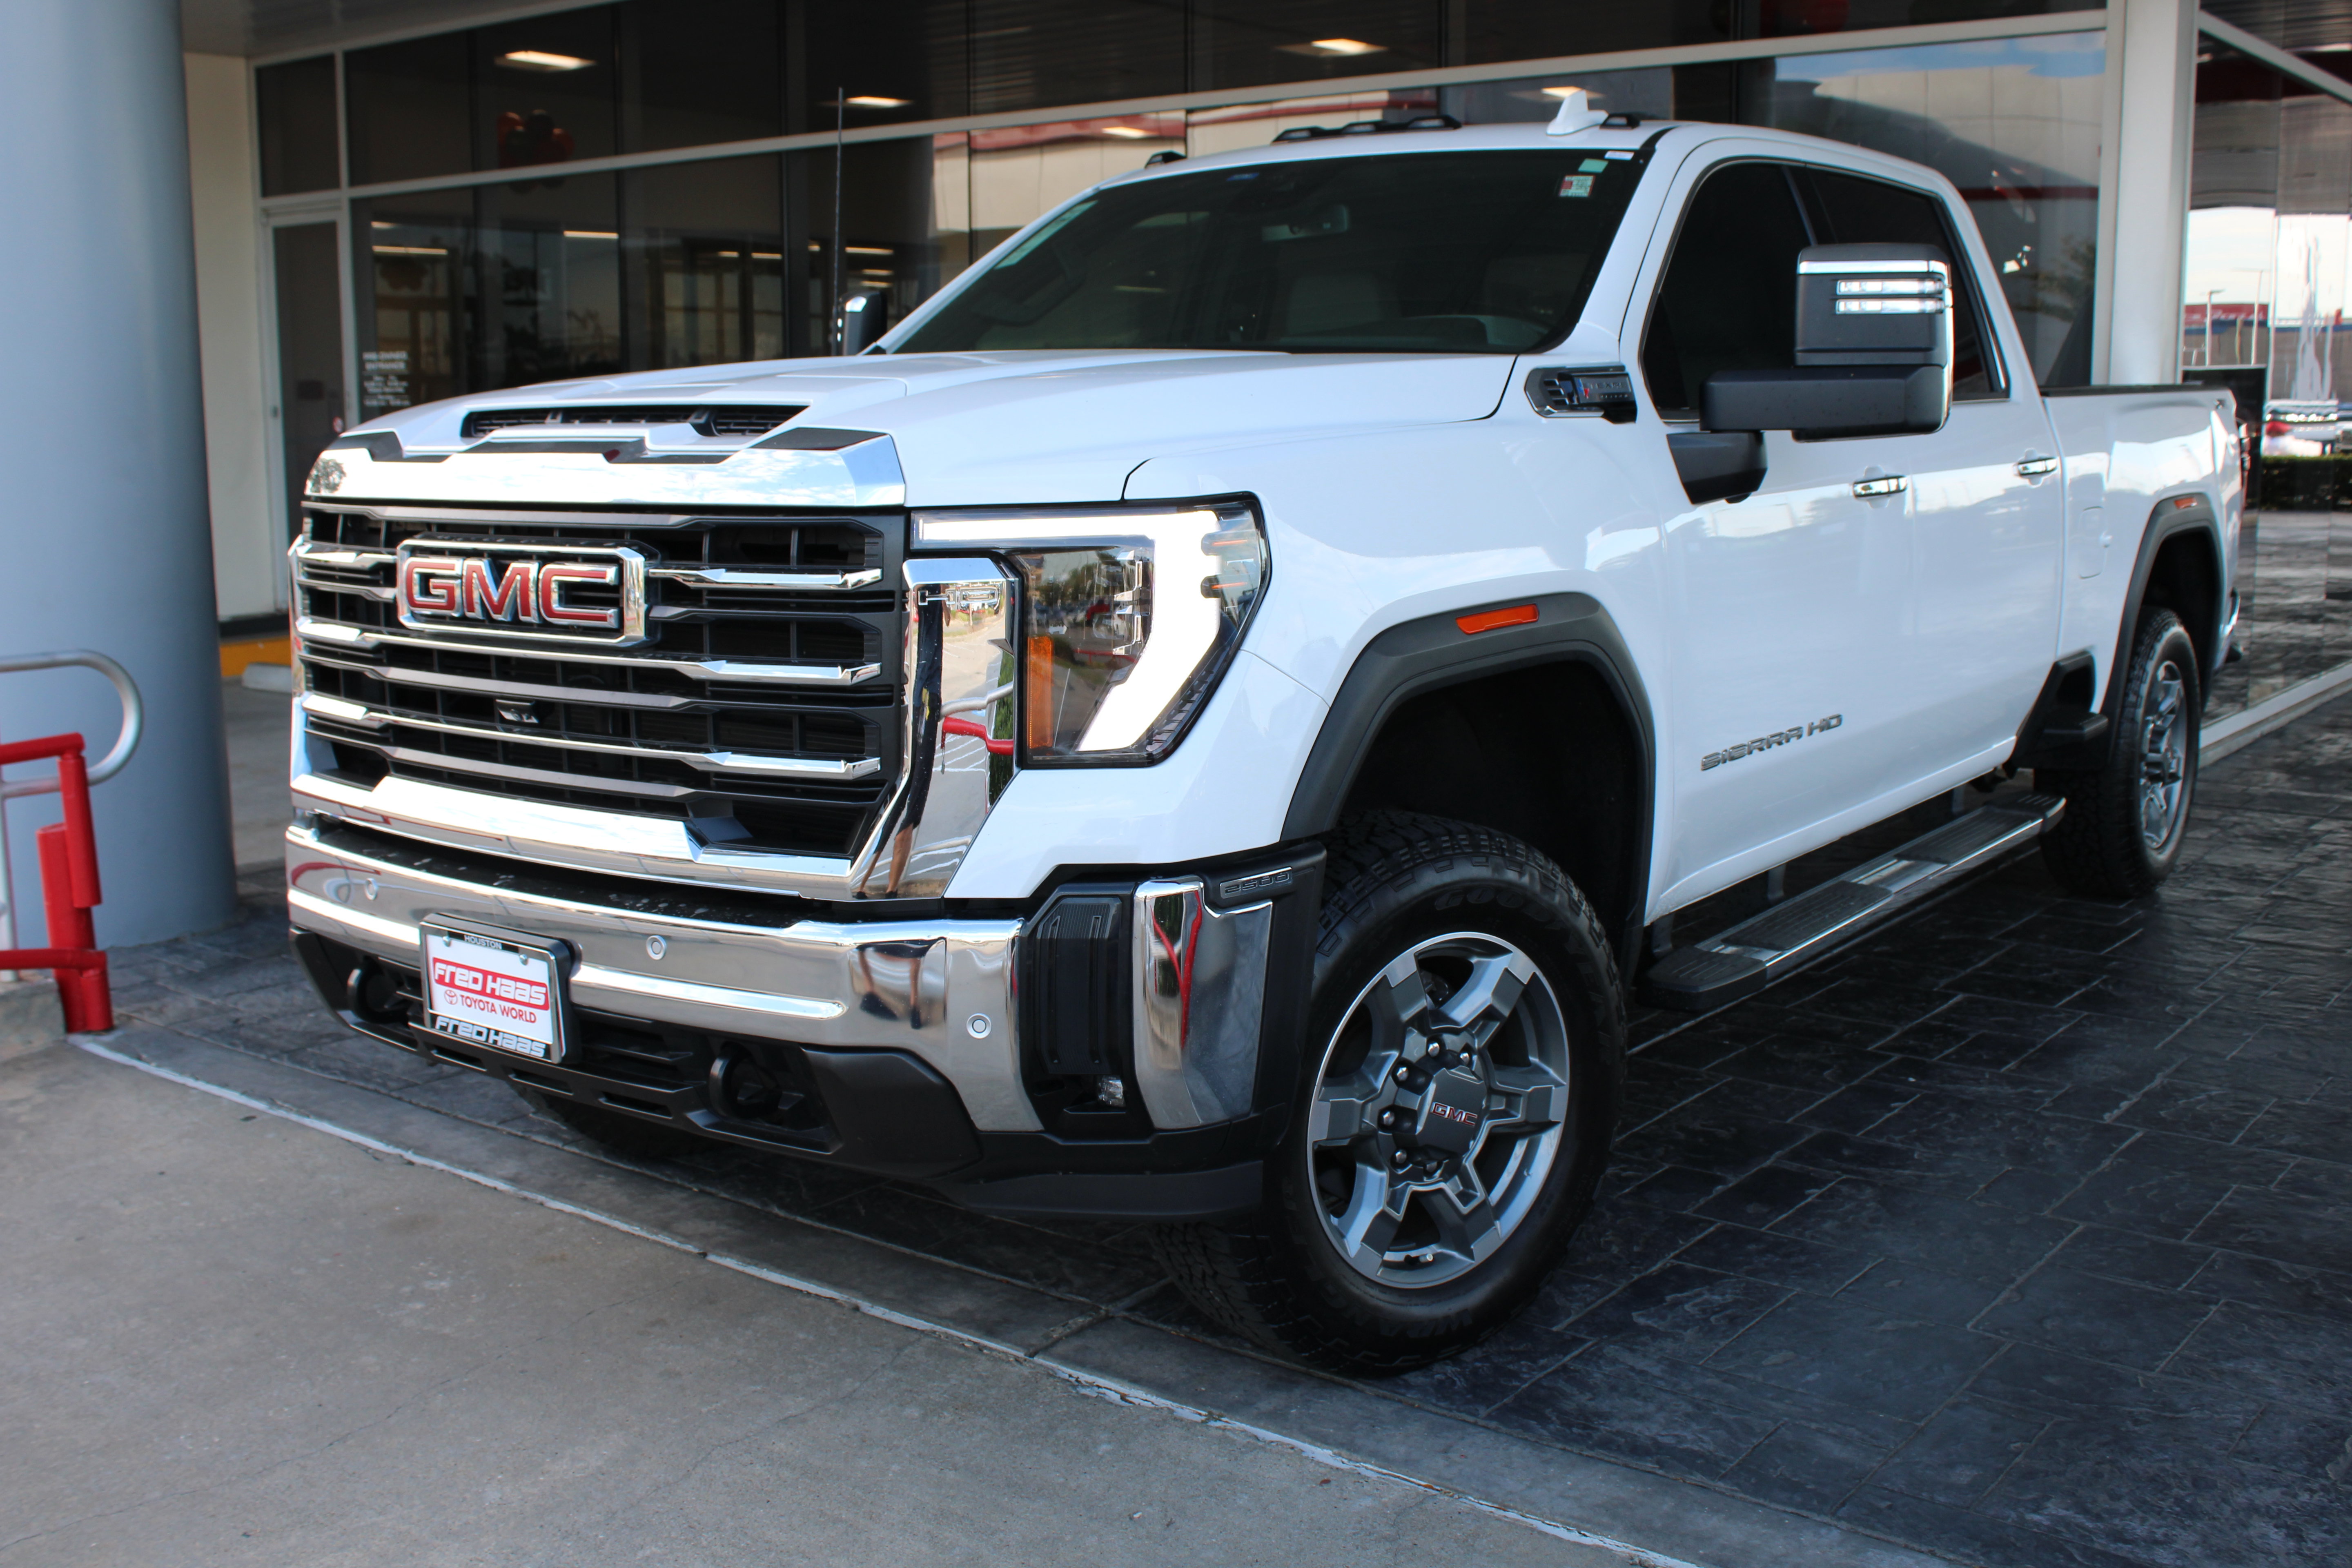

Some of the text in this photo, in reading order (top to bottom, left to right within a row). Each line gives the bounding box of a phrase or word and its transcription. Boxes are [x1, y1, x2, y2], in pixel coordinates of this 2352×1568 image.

[403, 556, 619, 629] GMC
[1700, 713, 1843, 771] SIERRA HD
[1225, 872, 1290, 895] 2500
[464, 935, 503, 950] HOUSTON
[459, 995, 537, 1024] TOYOTA WORLD
[1430, 1102, 1478, 1127] GMC
